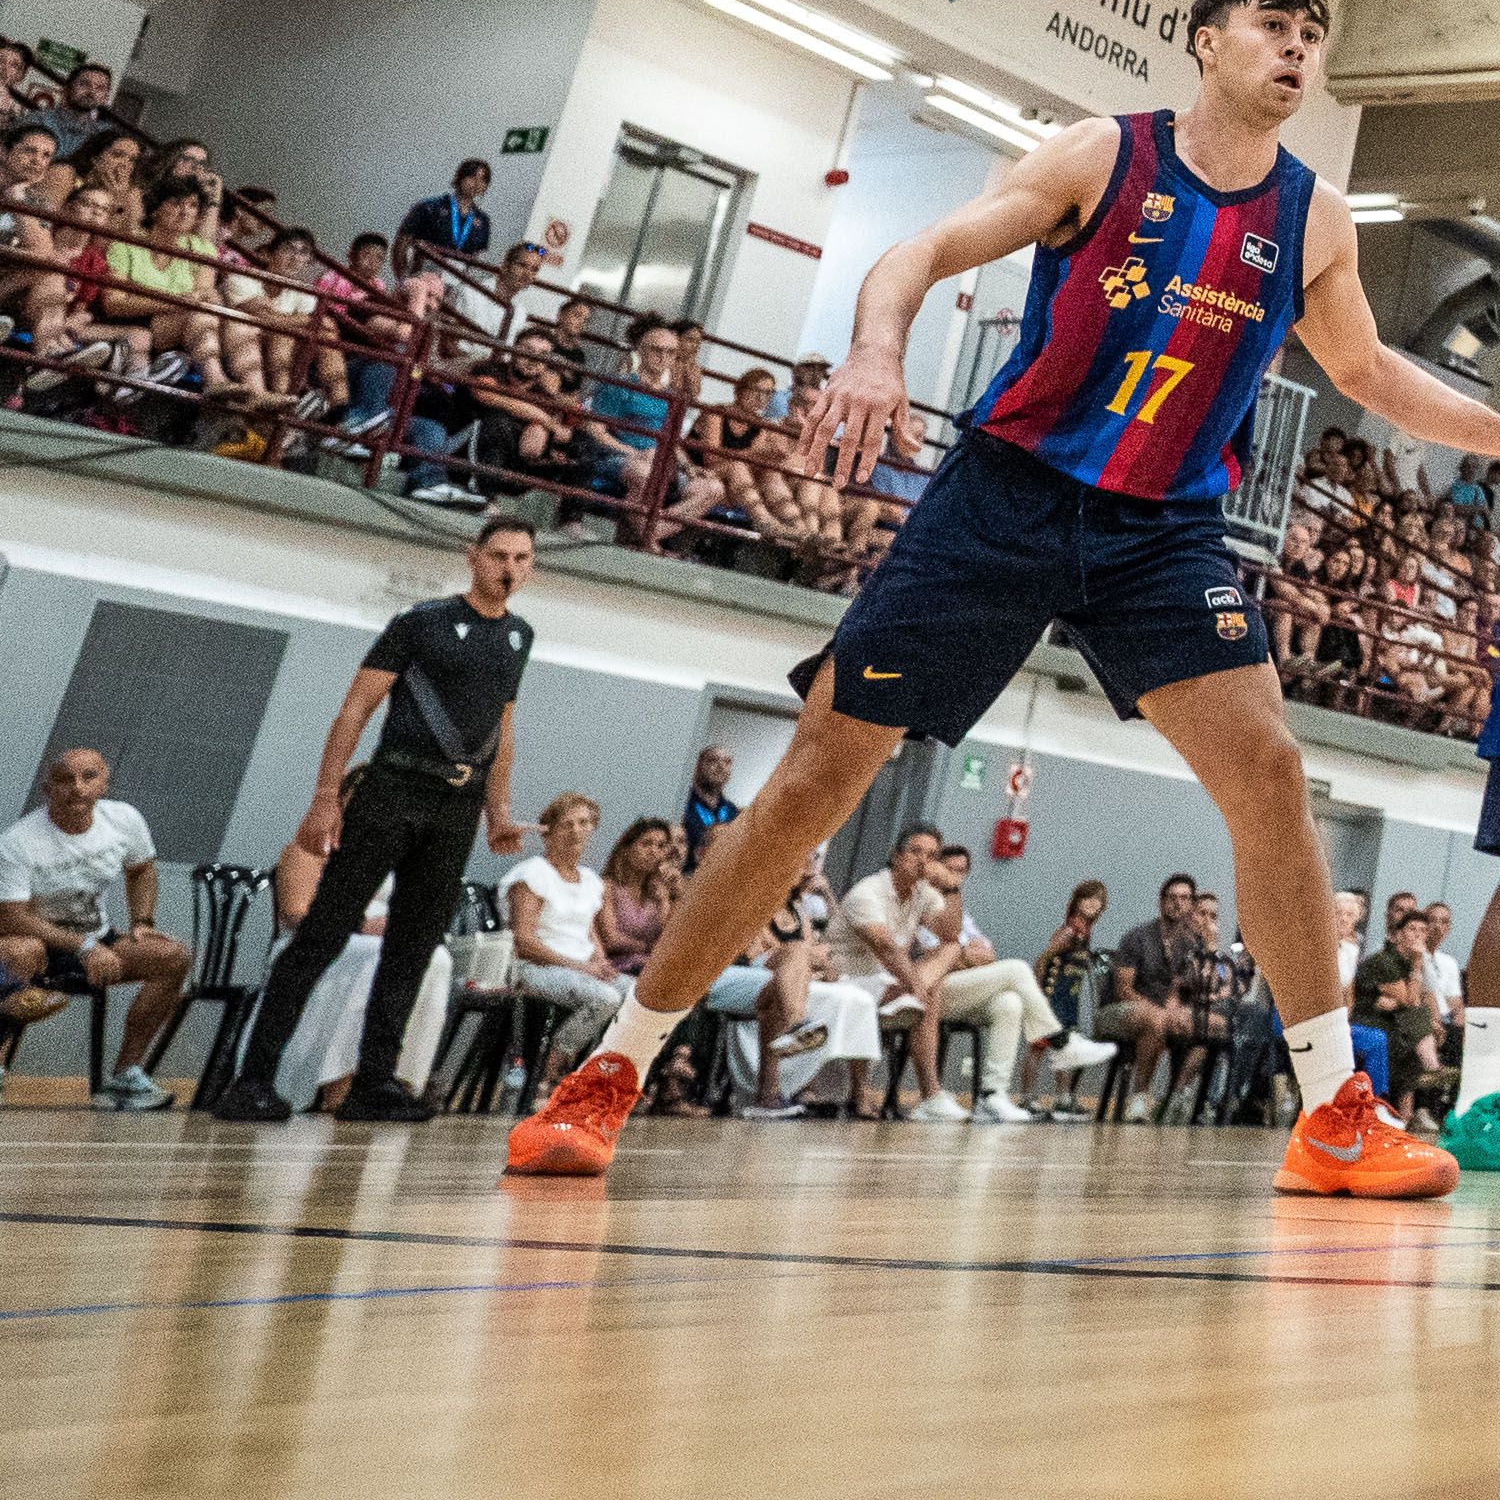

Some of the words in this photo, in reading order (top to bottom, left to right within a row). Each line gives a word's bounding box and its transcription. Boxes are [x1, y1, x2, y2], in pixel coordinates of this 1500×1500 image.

[1045, 10, 1149, 83] ANDORRA
[1157, 294, 1233, 333] Sanitària
[1164, 274, 1266, 323] Assistència
[1105, 350, 1195, 425] 17
